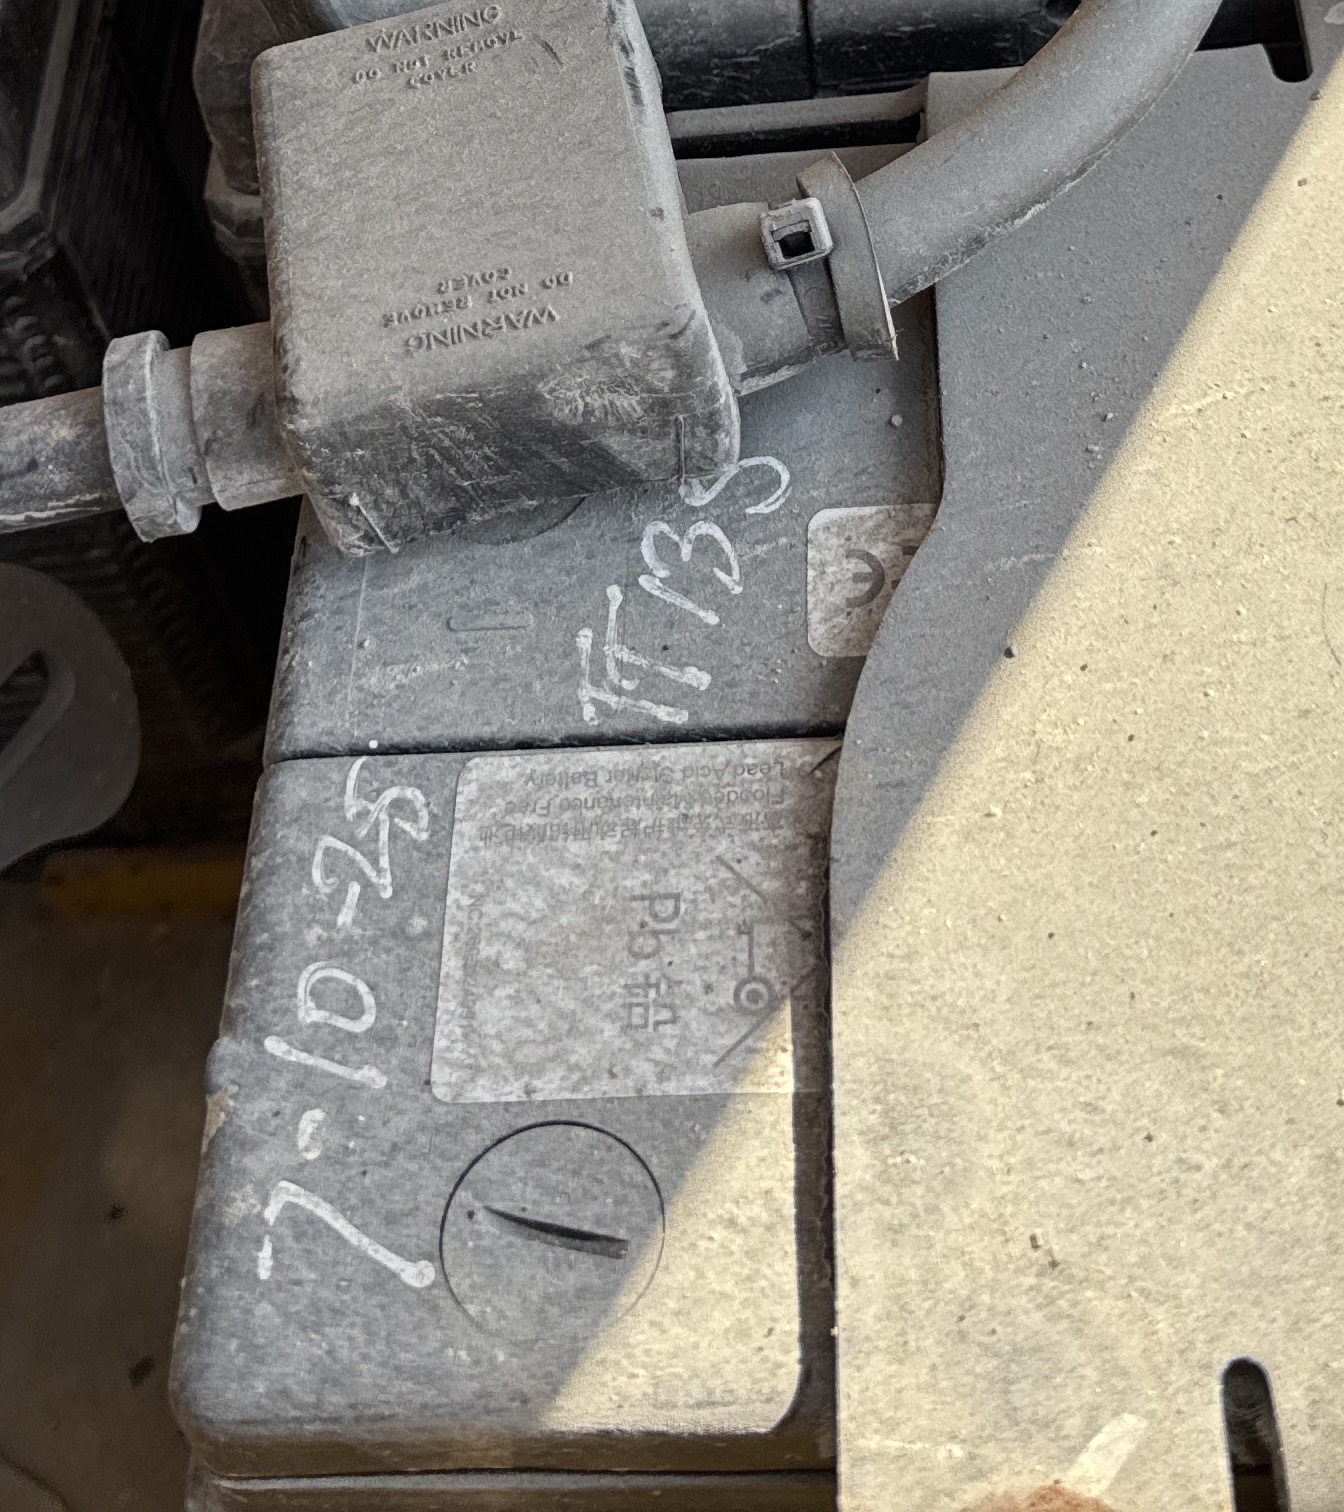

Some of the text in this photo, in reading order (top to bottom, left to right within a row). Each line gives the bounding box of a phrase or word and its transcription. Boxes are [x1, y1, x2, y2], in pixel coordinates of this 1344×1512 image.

[365, 4, 504, 54] WARNING
[352, 28, 526, 86] DO NOT REMOVE
[408, 61, 478, 89] COVER
[381, 270, 574, 329] DO NOT REMOVE
[436, 267, 513, 295] COVER
[404, 303, 560, 354] WARNING
[682, 763, 723, 782] Acid
[726, 761, 785, 780] Lead
[504, 798, 551, 817] Free
[620, 891, 685, 1034] Pb 铅
